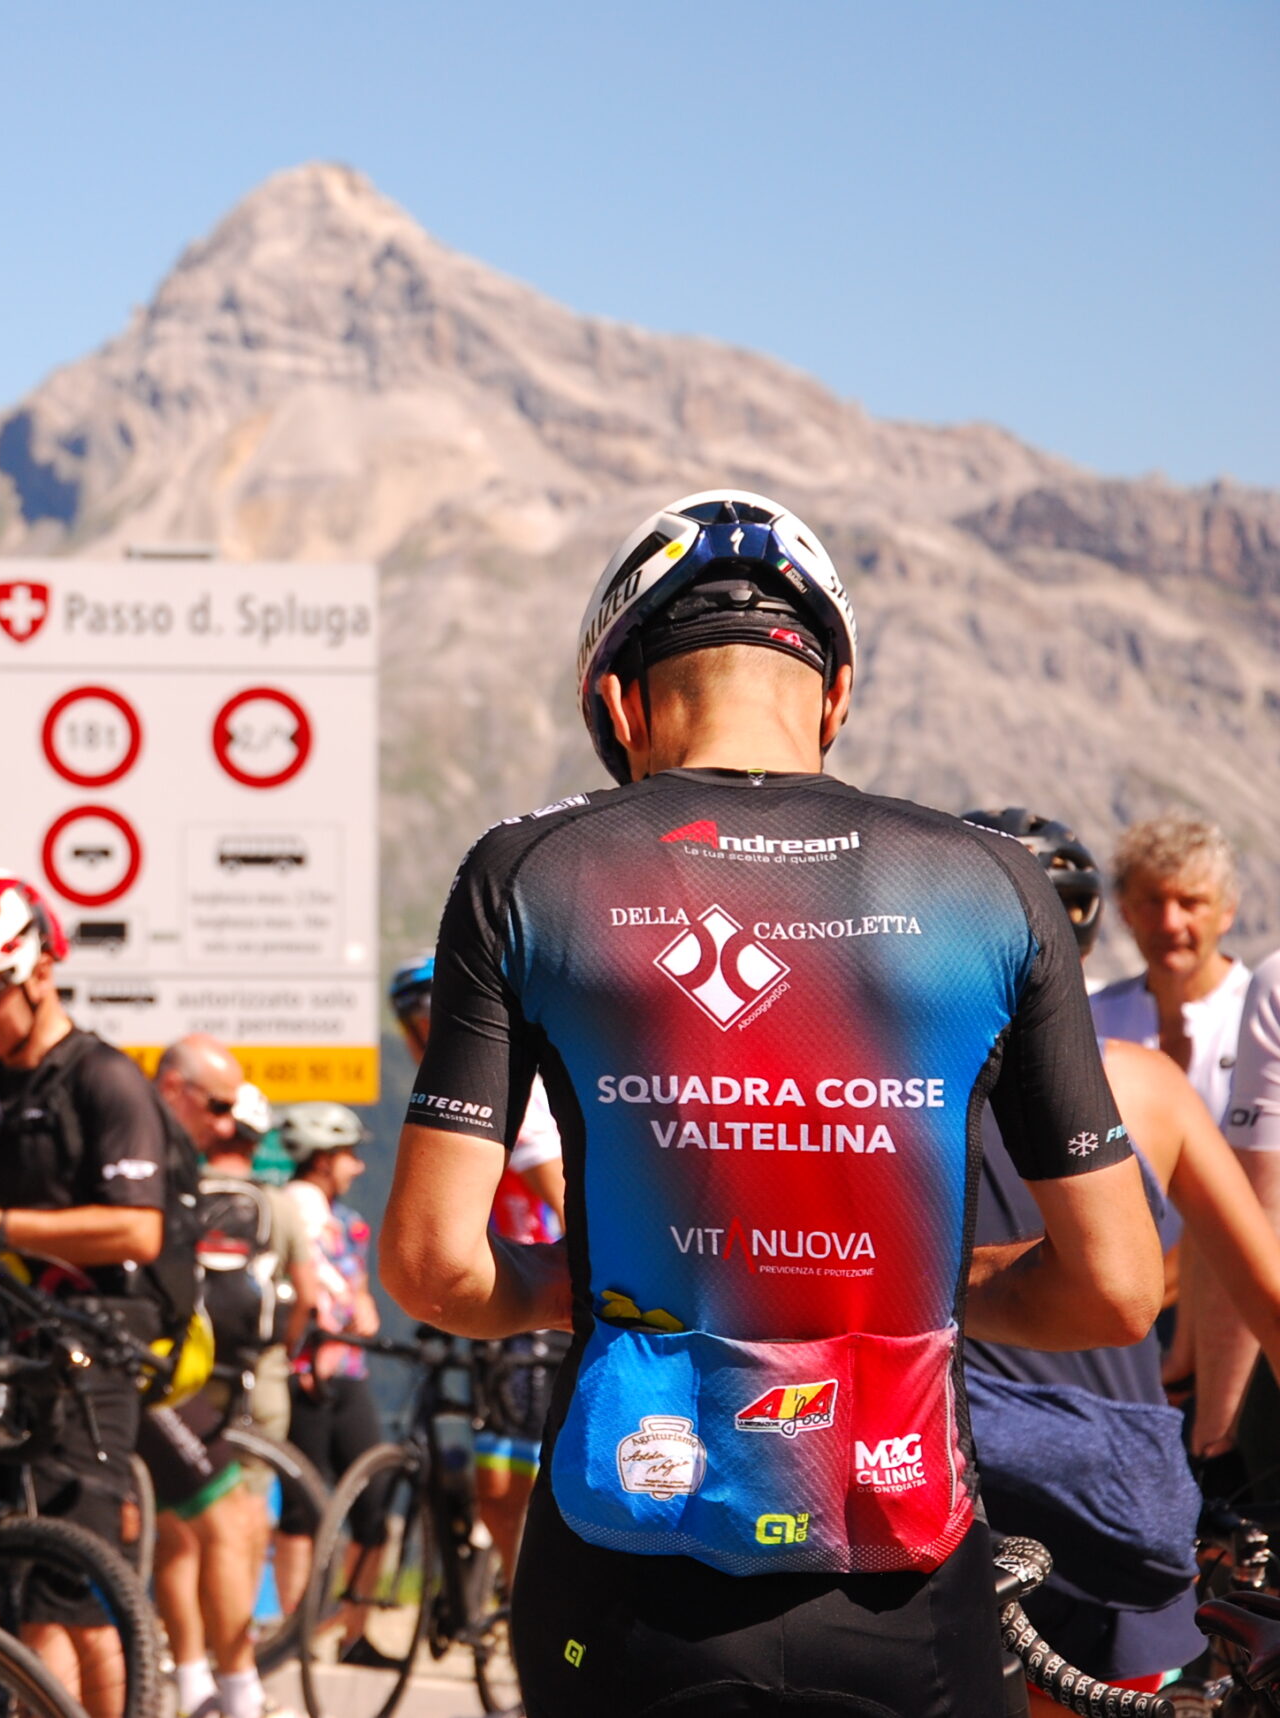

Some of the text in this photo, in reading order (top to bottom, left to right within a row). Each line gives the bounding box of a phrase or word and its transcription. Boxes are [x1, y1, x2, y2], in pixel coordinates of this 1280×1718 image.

[65, 594, 371, 646] Passo d. Spluga
[703, 849, 724, 859] tua
[729, 853, 770, 864] scelta
[774, 854, 786, 864] di
[791, 853, 838, 865] qualità
[610, 907, 922, 940] DELLA CAGNOLETTA
[597, 1075, 945, 1108] SQUADRA CORSE
[439, 1112, 494, 1129] ASSISTENZA
[651, 1120, 897, 1154] VALTELLINA
[759, 1264, 814, 1276] PREVIDENZA
[824, 1267, 875, 1278] PROTEZIONE
[631, 1432, 698, 1448] Agriturismo
[856, 1462, 925, 1485] CLINIC
